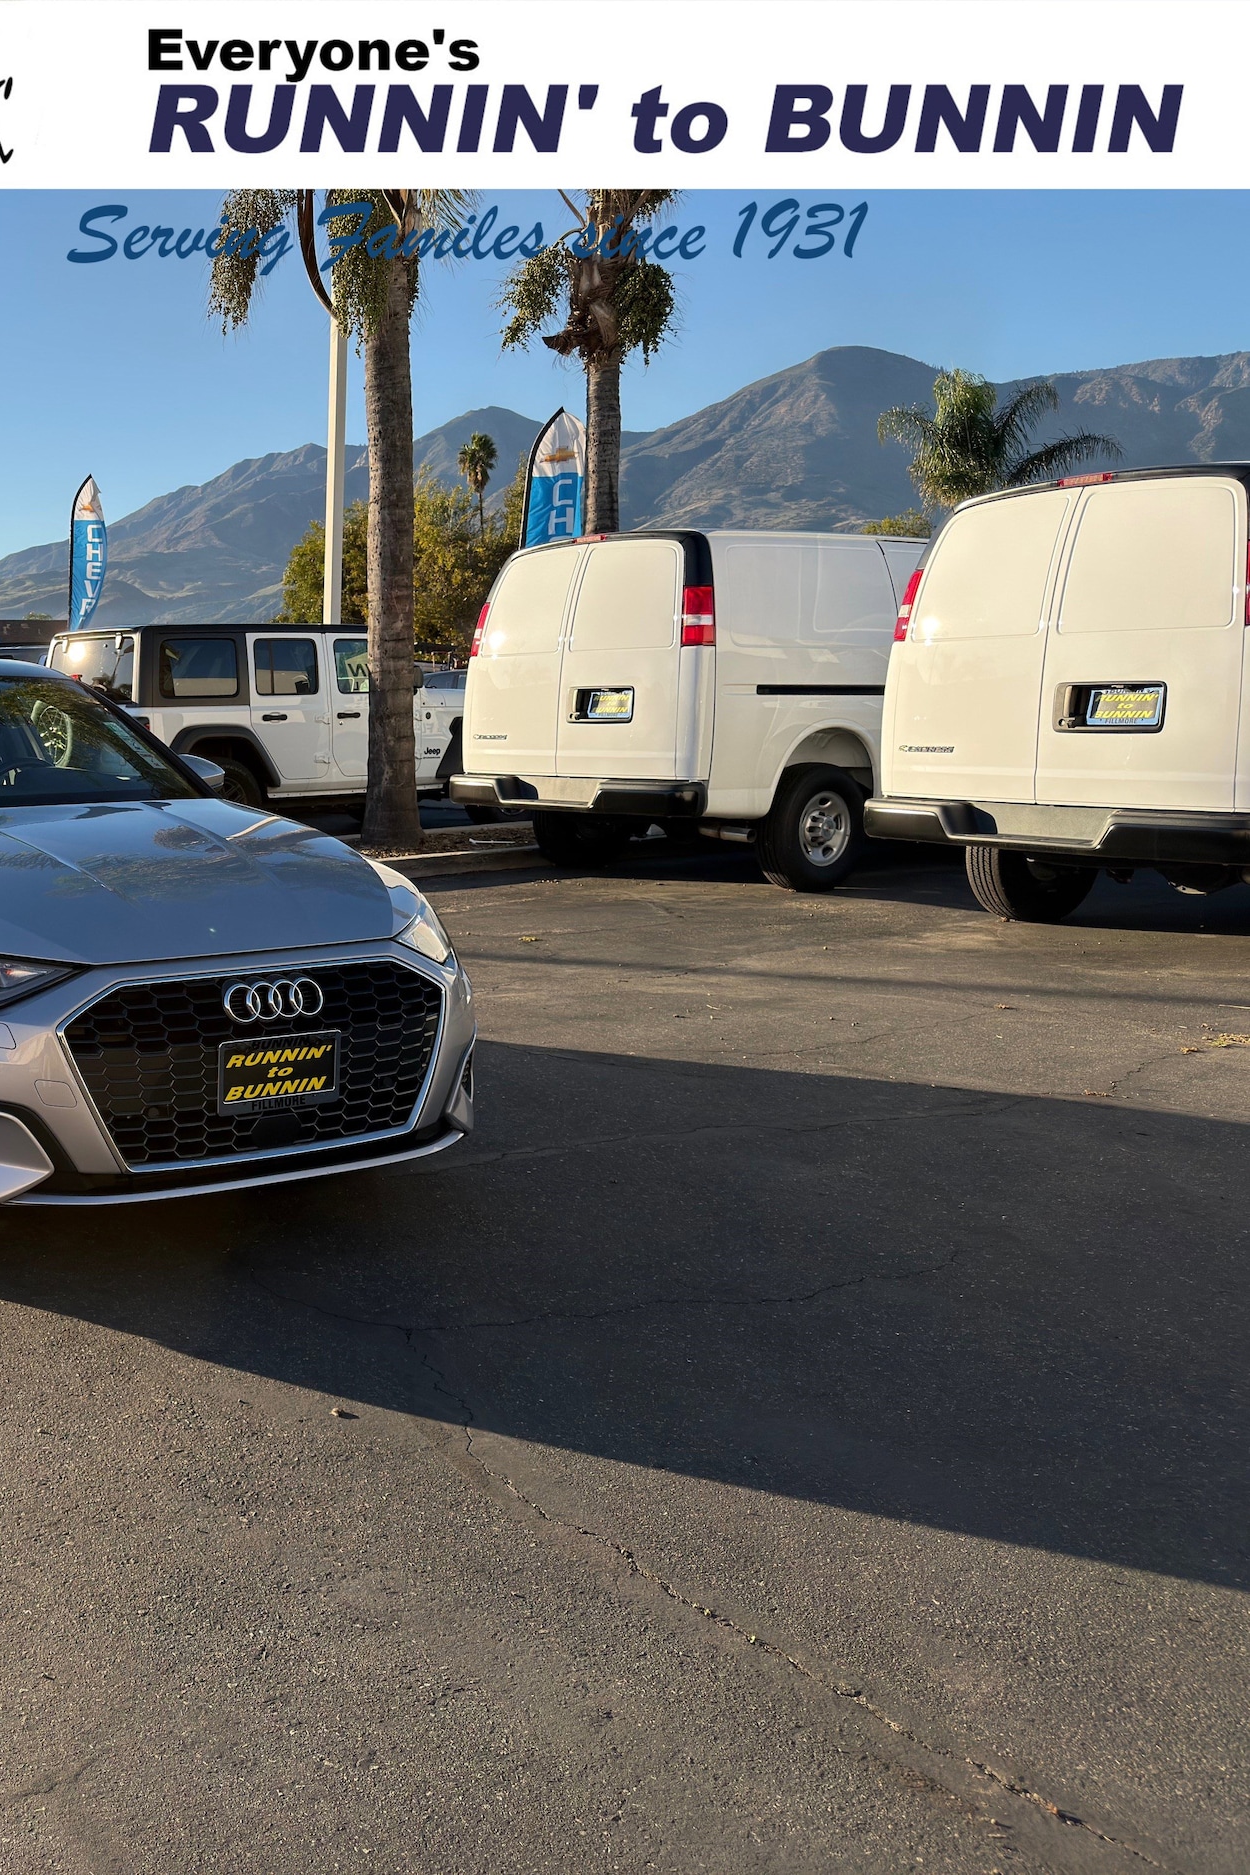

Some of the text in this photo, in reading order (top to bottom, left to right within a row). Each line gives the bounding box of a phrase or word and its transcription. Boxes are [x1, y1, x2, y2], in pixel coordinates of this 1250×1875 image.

[424, 747, 441, 755] Jeep
[226, 1045, 332, 1069] RUNNIN'
[267, 1066, 294, 1078] to
[225, 1076, 327, 1101] BUNNIN
[252, 1096, 306, 1111] FILLMORE
